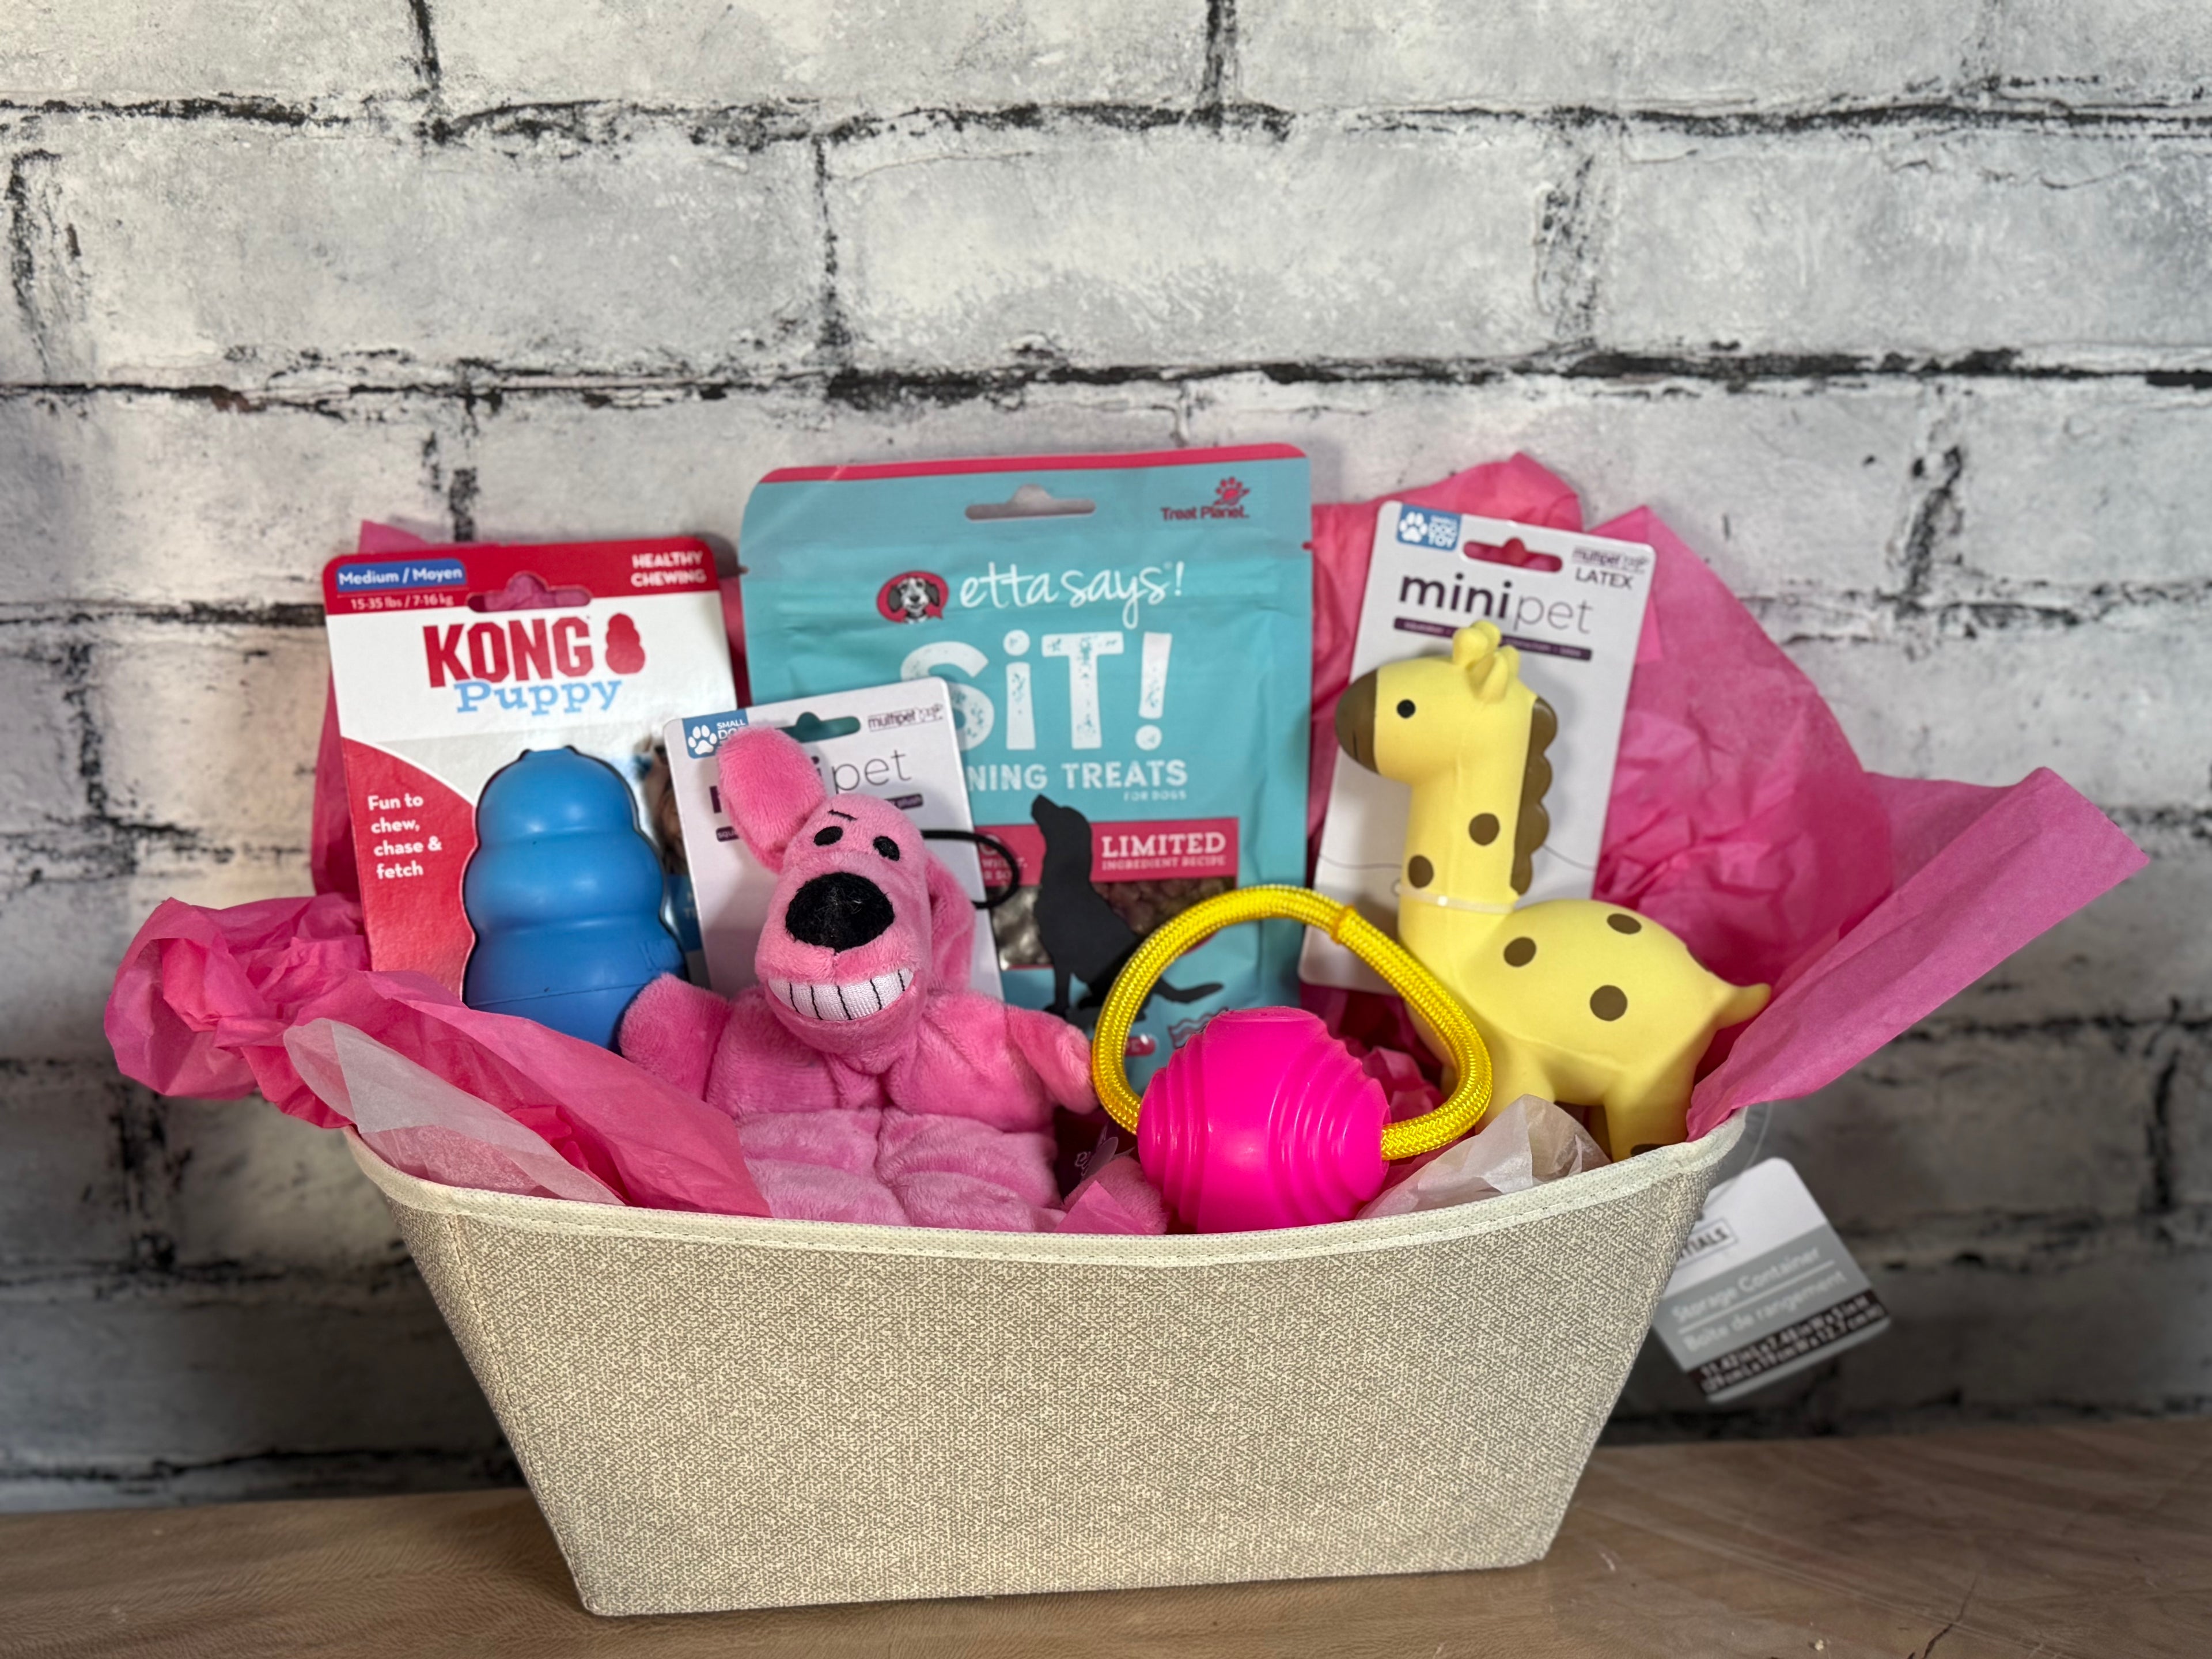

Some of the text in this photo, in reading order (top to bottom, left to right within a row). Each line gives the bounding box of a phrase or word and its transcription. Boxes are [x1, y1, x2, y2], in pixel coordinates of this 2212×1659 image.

[1160, 506, 1197, 521] Treat
[1429, 521, 1457, 537] DOG
[1428, 533, 1456, 548] TOY
[632, 550, 703, 569] HEALTHY
[338, 567, 463, 585] Medium / Moyen
[630, 569, 707, 588] CHEWING
[960, 561, 1059, 608] etta
[1575, 567, 1634, 590] LATEX
[351, 592, 454, 609] 15-35 lbs / 7-16 kg
[423, 616, 594, 688] KONG
[453, 680, 623, 716] Puppy
[717, 719, 746, 730] SMALL
[718, 728, 741, 740] DO
[967, 759, 1188, 791] NING TREATS
[368, 793, 424, 810] Fun to
[1124, 790, 1187, 801] FOR DOGS
[370, 817, 421, 834] chew,
[373, 835, 442, 857] chase &
[1101, 832, 1226, 858] LIMITED
[376, 860, 424, 880] fetch
[1102, 855, 1226, 870] INGREDIENT RECIPE
[1672, 1248, 1820, 1323] Storage Container
[1732, 1313, 1755, 1332] de
[1755, 1271, 1846, 1319] rangement
